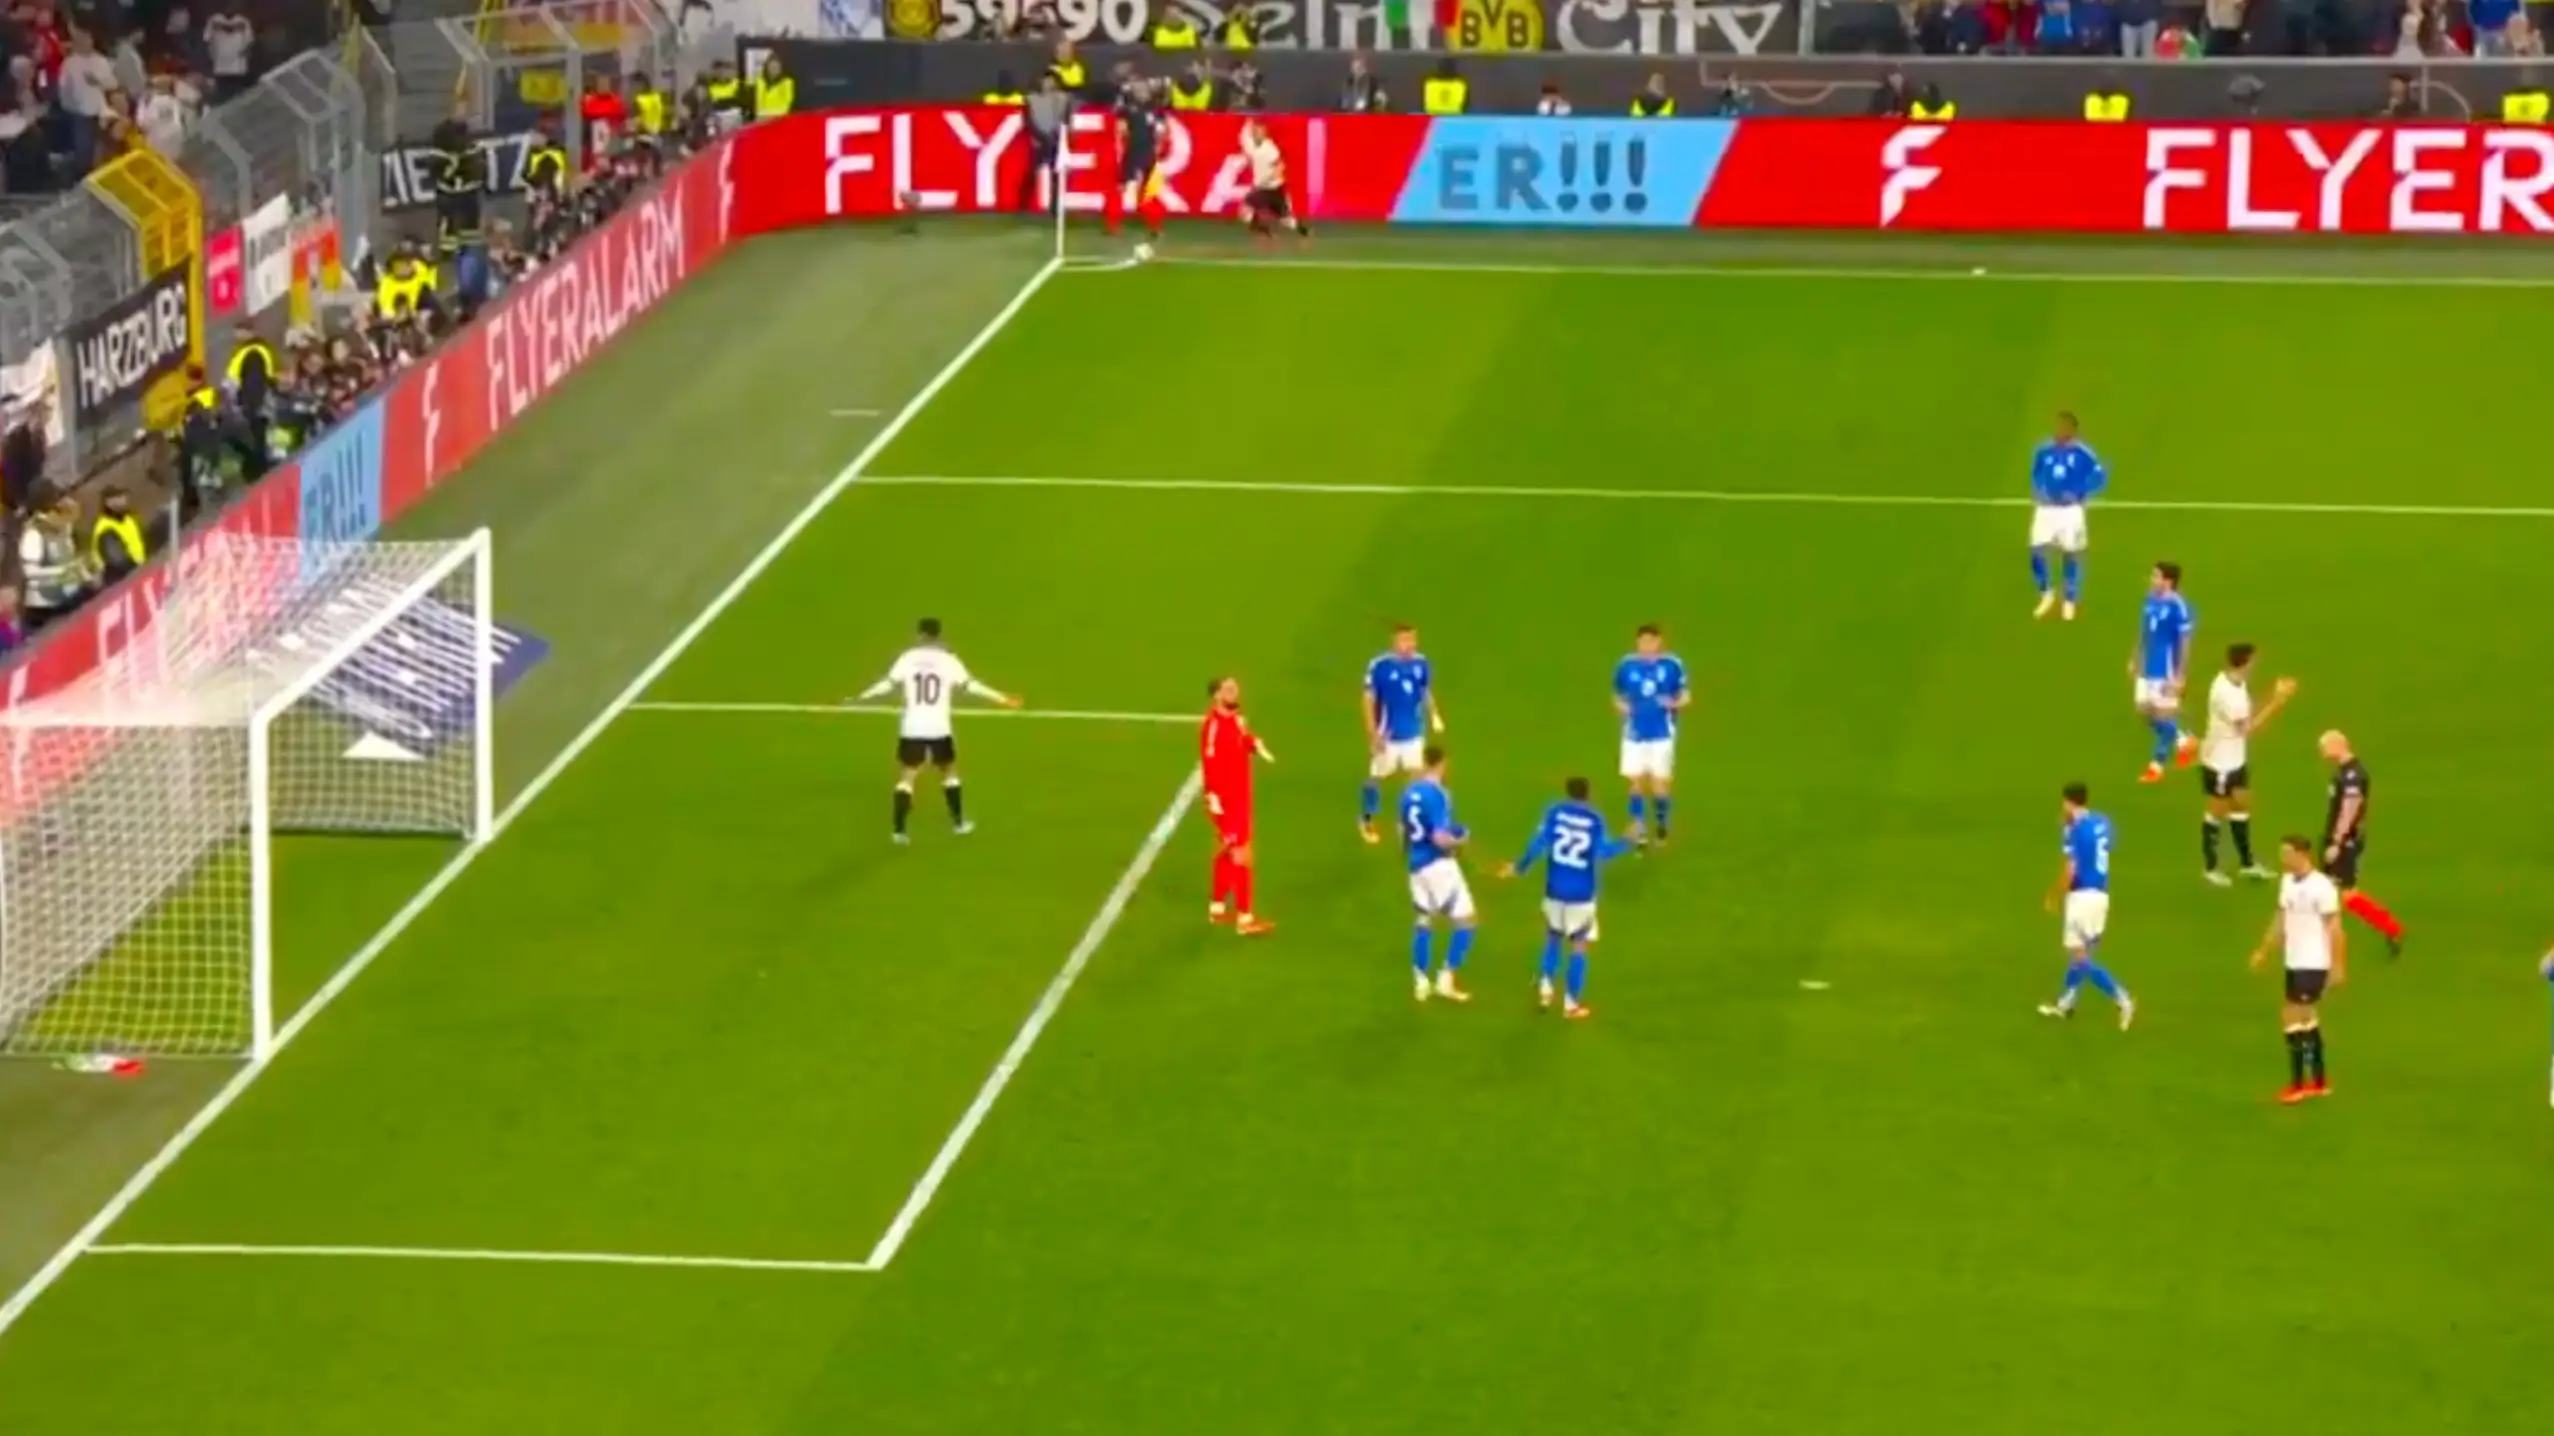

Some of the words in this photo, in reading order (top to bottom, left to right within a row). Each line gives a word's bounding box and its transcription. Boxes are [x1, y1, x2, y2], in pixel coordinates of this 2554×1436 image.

[1460, 0, 1529, 48] BVB
[1556, 0, 1782, 54] City
[486, 182, 686, 432] FLYERALARM
[76, 281, 188, 410] HARZBURG
[913, 671, 942, 706] 10
[1408, 804, 1425, 842] 5
[1553, 824, 1591, 869] 22
